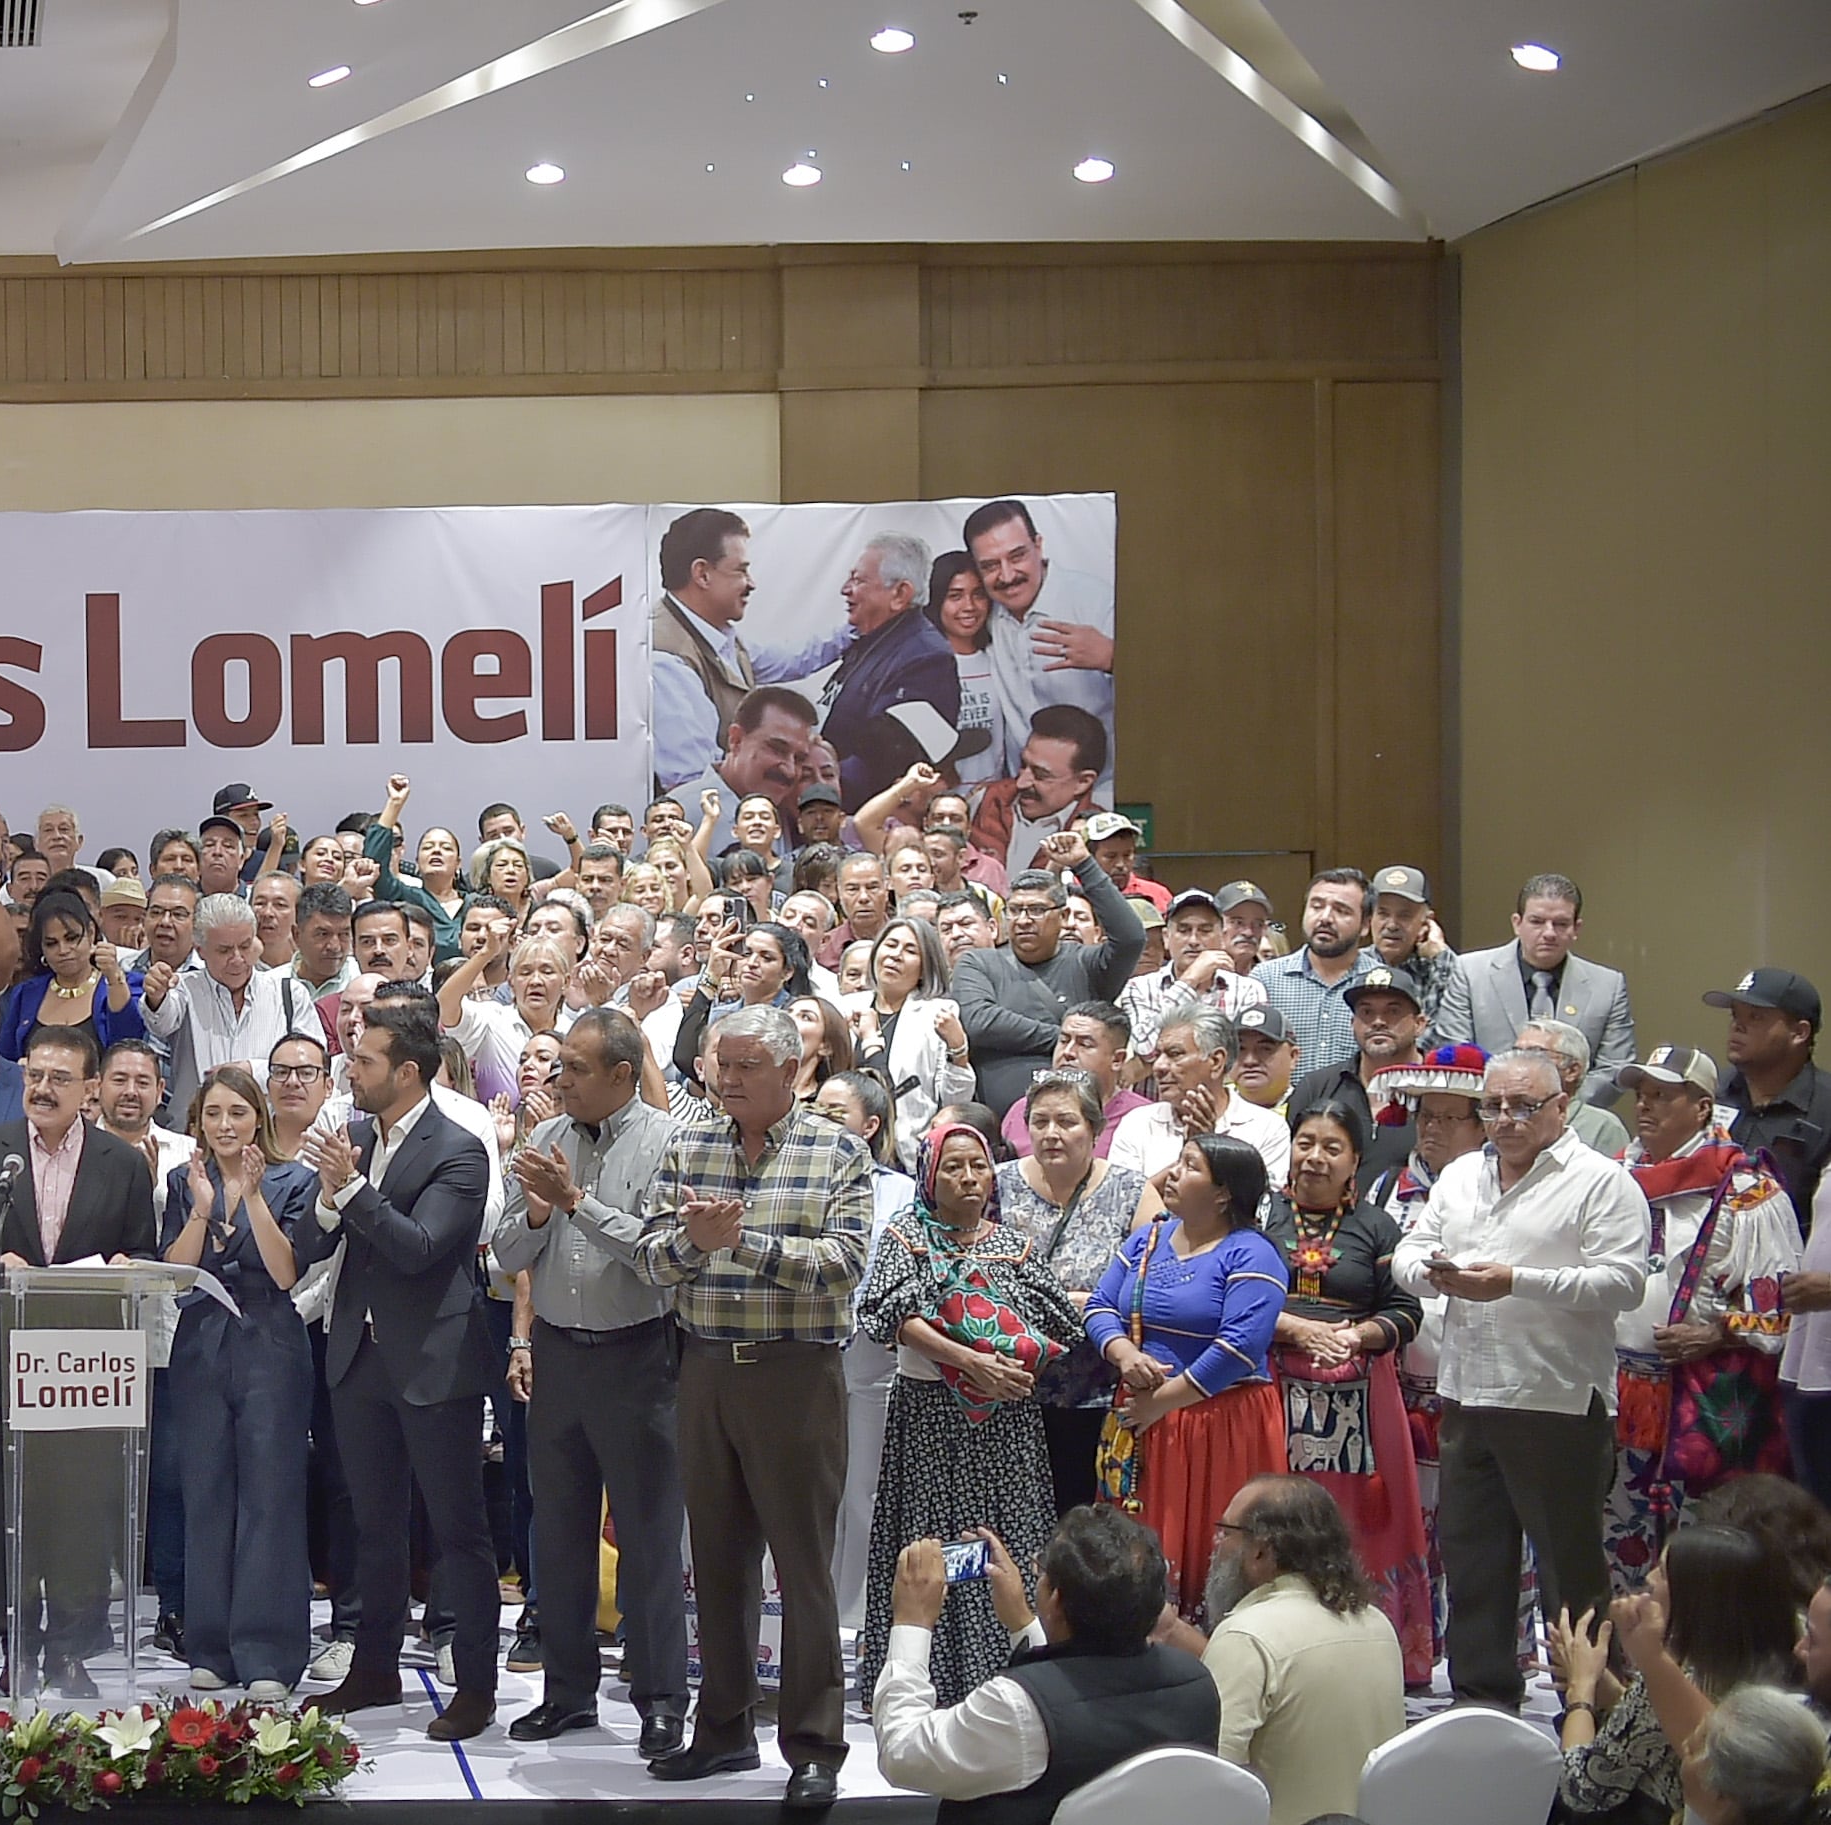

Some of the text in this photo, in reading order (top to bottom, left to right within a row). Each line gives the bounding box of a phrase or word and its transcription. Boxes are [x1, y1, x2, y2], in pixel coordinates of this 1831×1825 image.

[86, 578, 622, 746] Lomelí
[16, 1350, 135, 1374] Dr. Carlos
[17, 1376, 136, 1408] Lomelí
